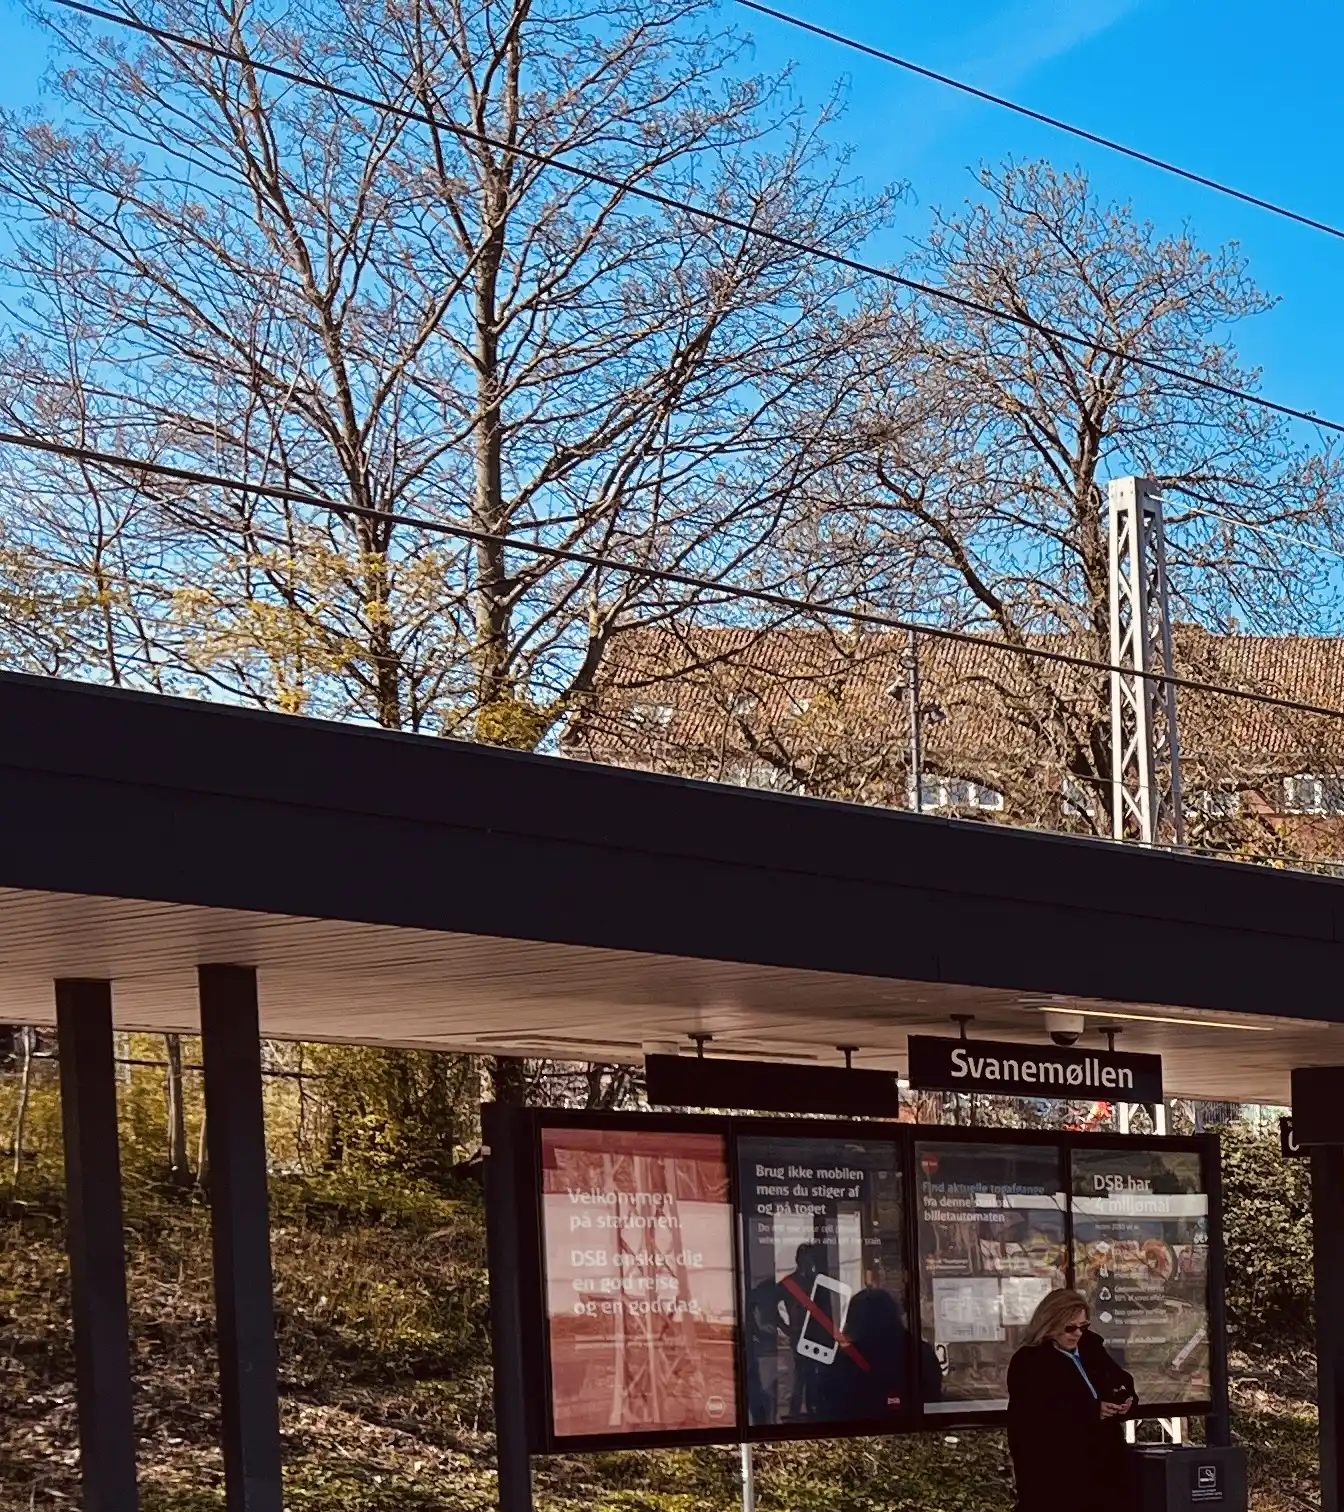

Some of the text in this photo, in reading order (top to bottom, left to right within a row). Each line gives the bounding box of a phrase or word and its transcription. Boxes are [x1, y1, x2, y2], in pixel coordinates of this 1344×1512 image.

[950, 1048, 1133, 1089] Svanemøllen
[756, 1164, 864, 1180] Brug ikke mobilen
[923, 1181, 945, 1194] Find
[947, 1182, 988, 1194] aktuelle
[1093, 1174, 1151, 1191] DSB har
[568, 1187, 673, 1205] Velkommen
[757, 1184, 860, 1199] mens du stiger af
[757, 1201, 827, 1217] og på toget
[924, 1196, 937, 1207] fra
[940, 1196, 971, 1208] denne
[570, 1213, 682, 1232] på stationen.
[924, 1210, 1006, 1223] billetautomaten
[571, 1250, 703, 1268] DSB ønsker dig
[572, 1275, 679, 1293] en god rejse
[574, 1302, 596, 1317] og
[602, 1300, 623, 1313] en
[629, 1298, 662, 1316] god
